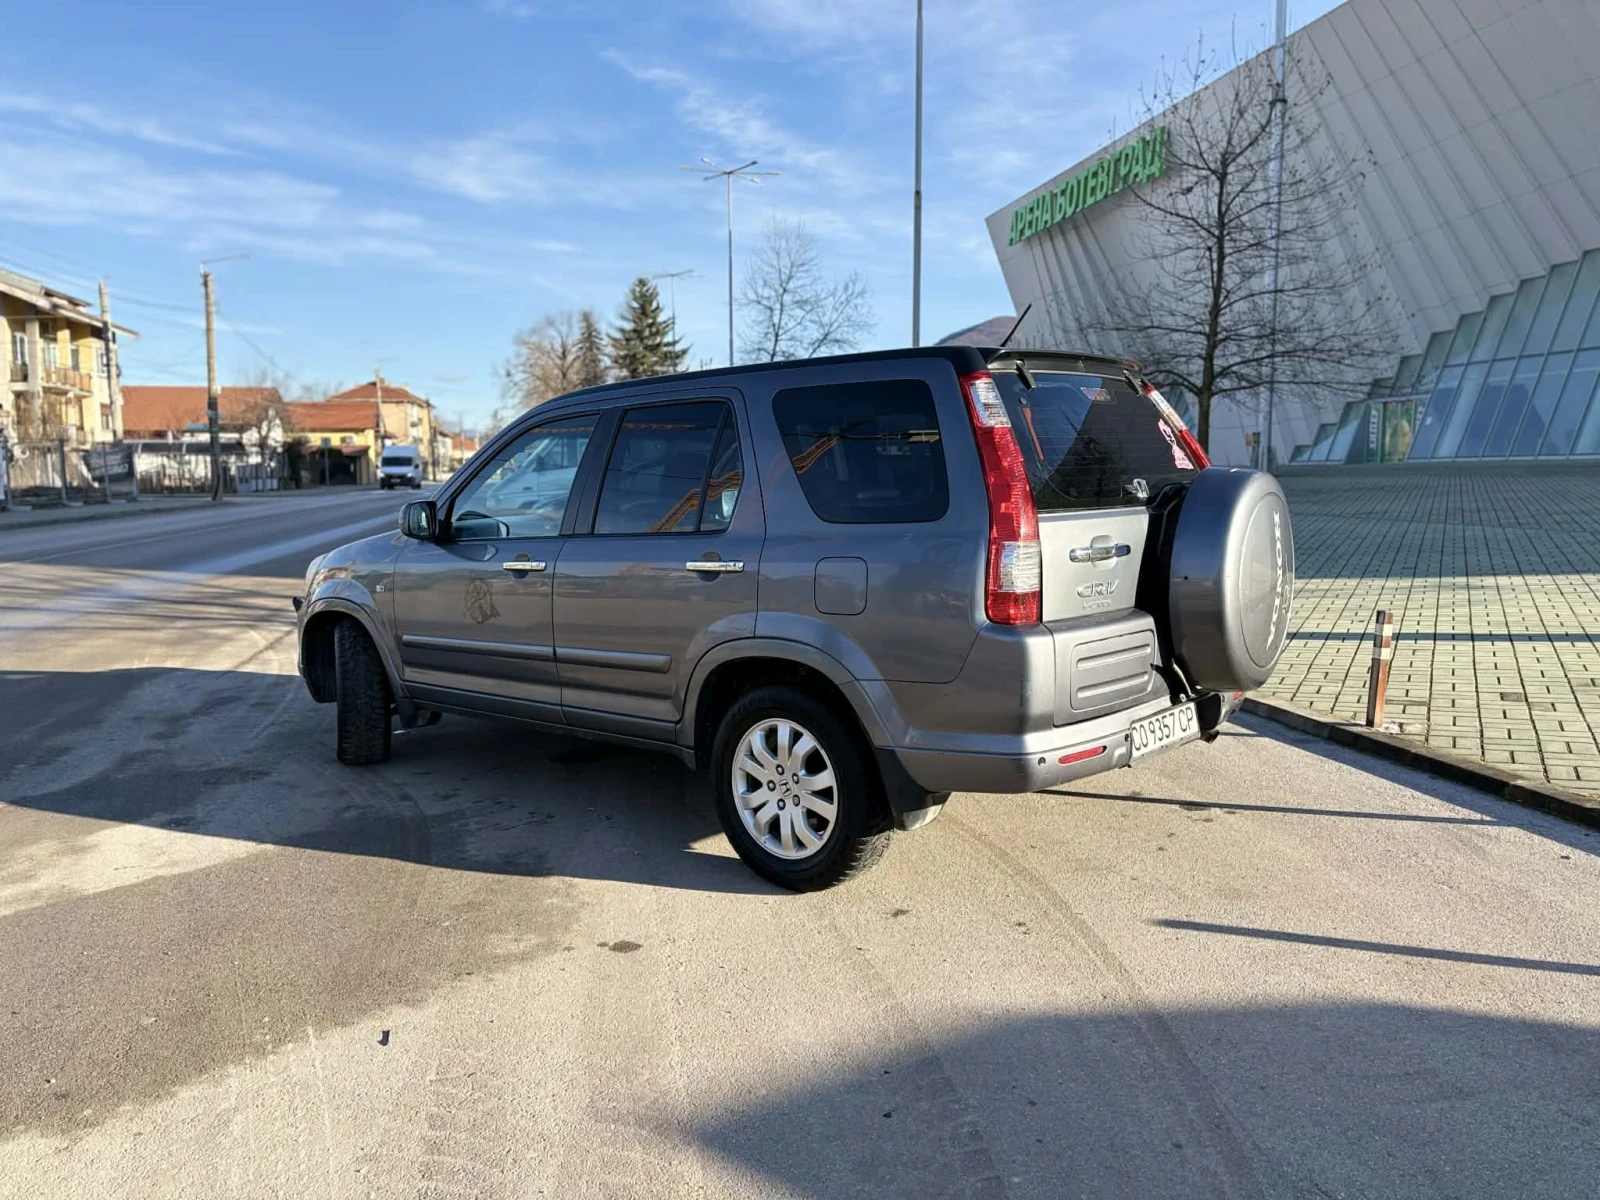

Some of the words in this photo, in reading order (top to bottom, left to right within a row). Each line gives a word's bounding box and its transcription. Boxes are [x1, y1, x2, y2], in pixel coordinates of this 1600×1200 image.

[1007, 190, 1053, 246] АРЕНА
[1053, 125, 1167, 223] БОТЕВГРАД
[1266, 510, 1283, 651] HONDA
[1131, 724, 1149, 751] CO
[1148, 711, 1175, 745] 9357
[1178, 706, 1194, 732] CP
